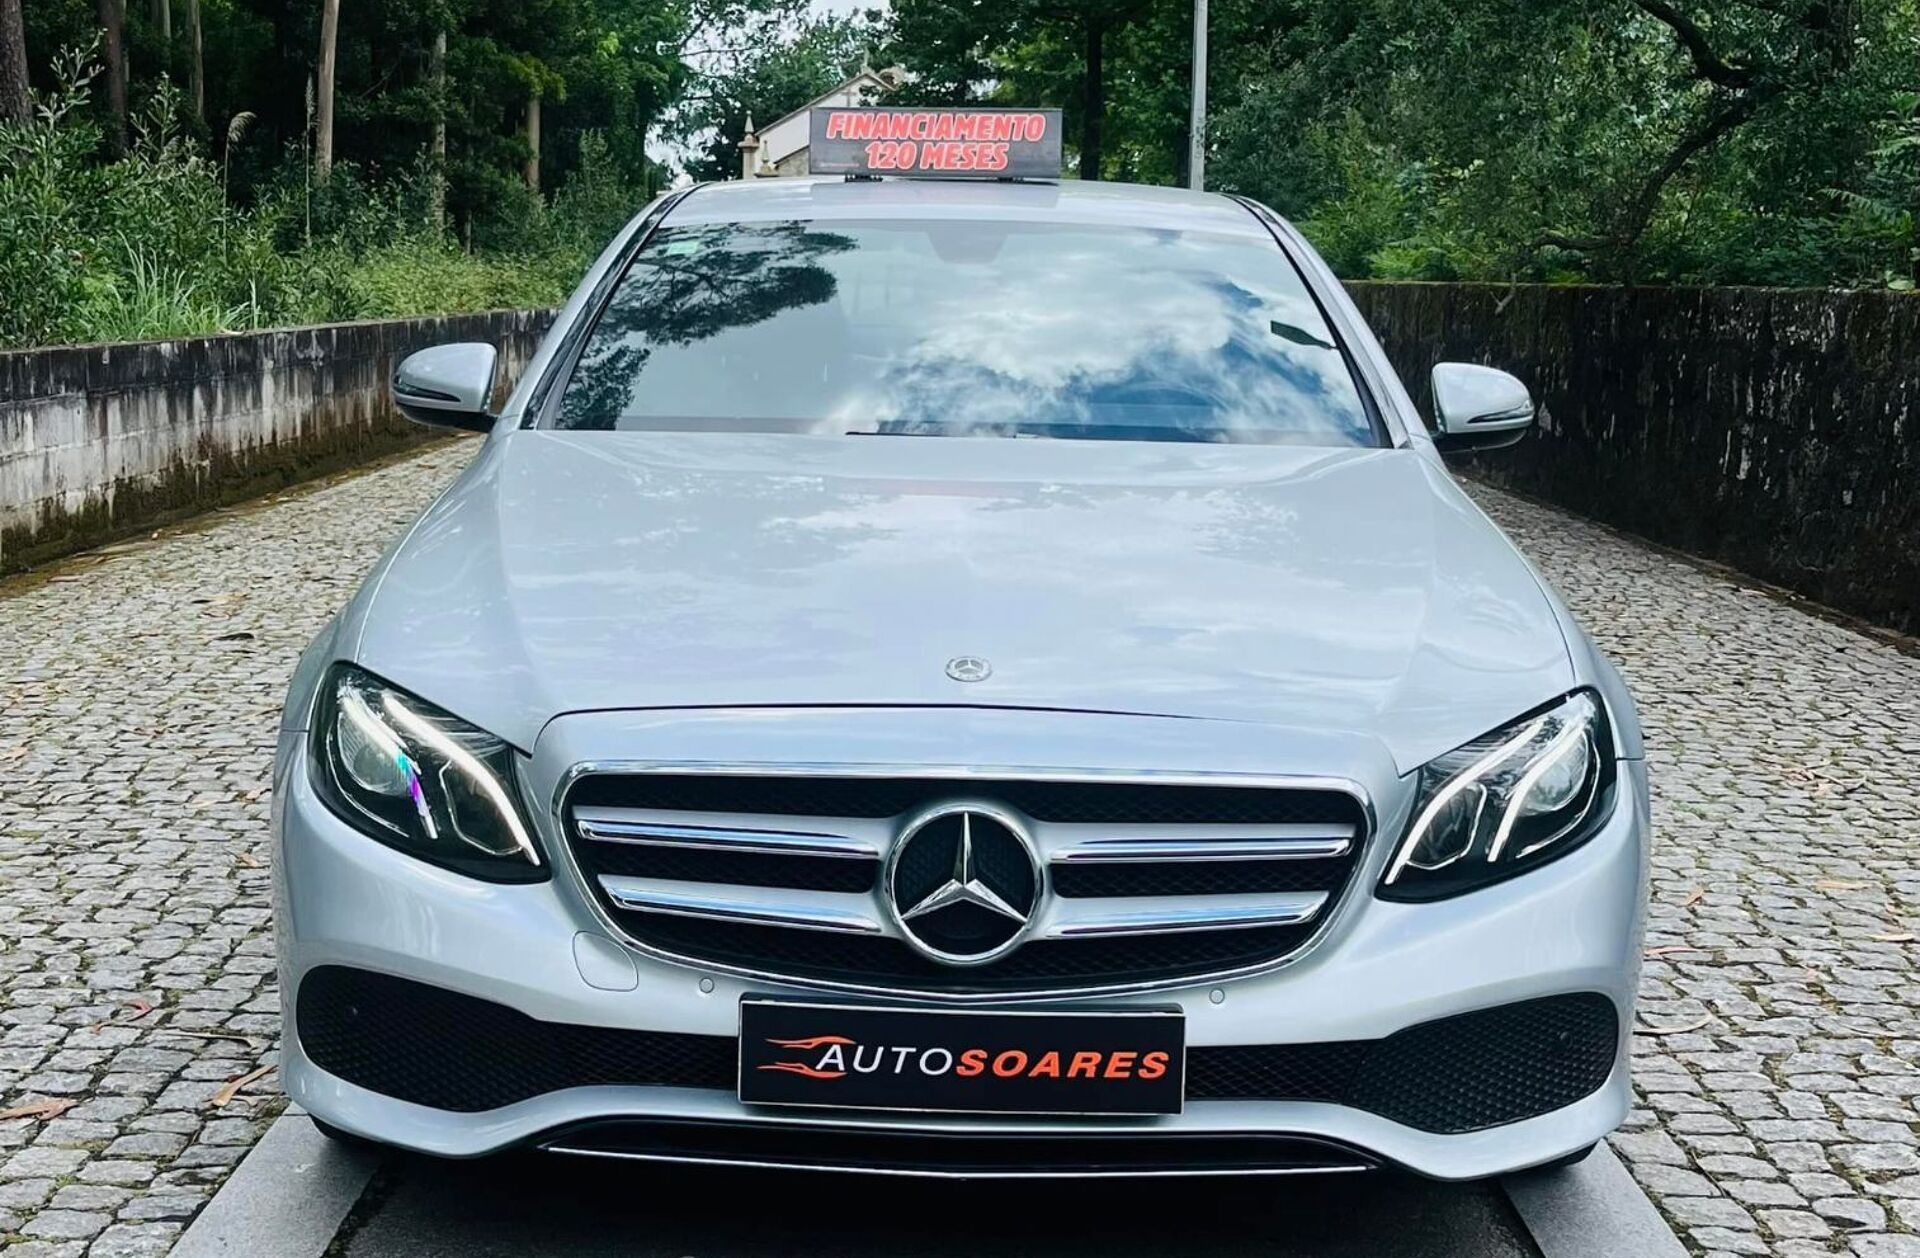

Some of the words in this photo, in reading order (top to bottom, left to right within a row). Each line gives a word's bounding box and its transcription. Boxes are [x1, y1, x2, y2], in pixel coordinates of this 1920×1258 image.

[826, 111, 1046, 142] FINANCIAMENTO
[865, 142, 917, 169] 120
[919, 143, 1008, 170] MESES
[815, 1043, 1169, 1079] AUTOSOARES
